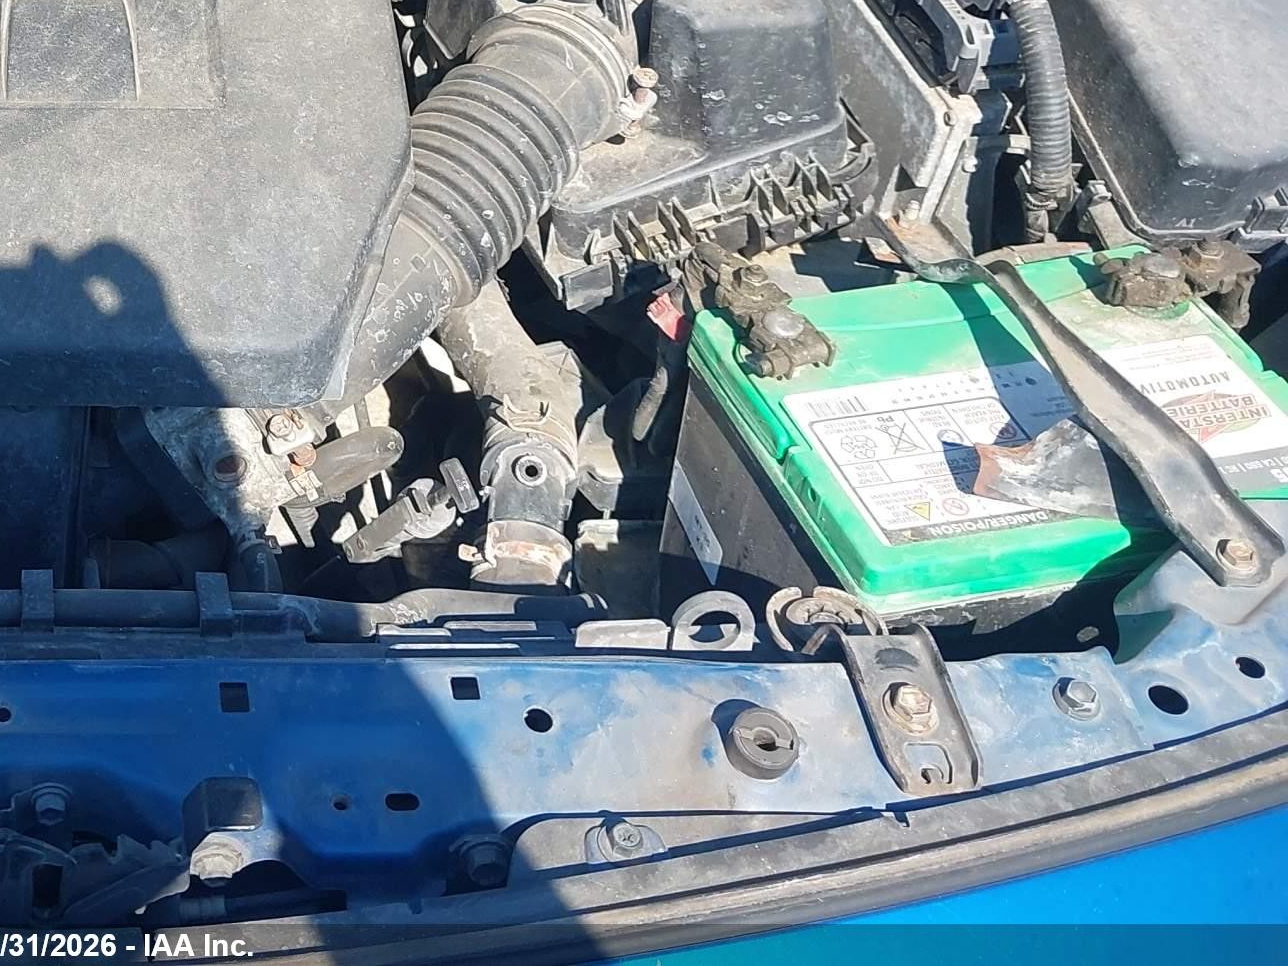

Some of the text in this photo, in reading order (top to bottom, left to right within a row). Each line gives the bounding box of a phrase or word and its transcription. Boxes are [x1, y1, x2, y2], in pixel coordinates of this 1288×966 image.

[1138, 370, 1231, 395] AUTOMOTIV
[1168, 395, 1255, 417] BATTERIE
[1178, 405, 1268, 429] INTERSTA
[927, 510, 1049, 537] DANGER/POISON
